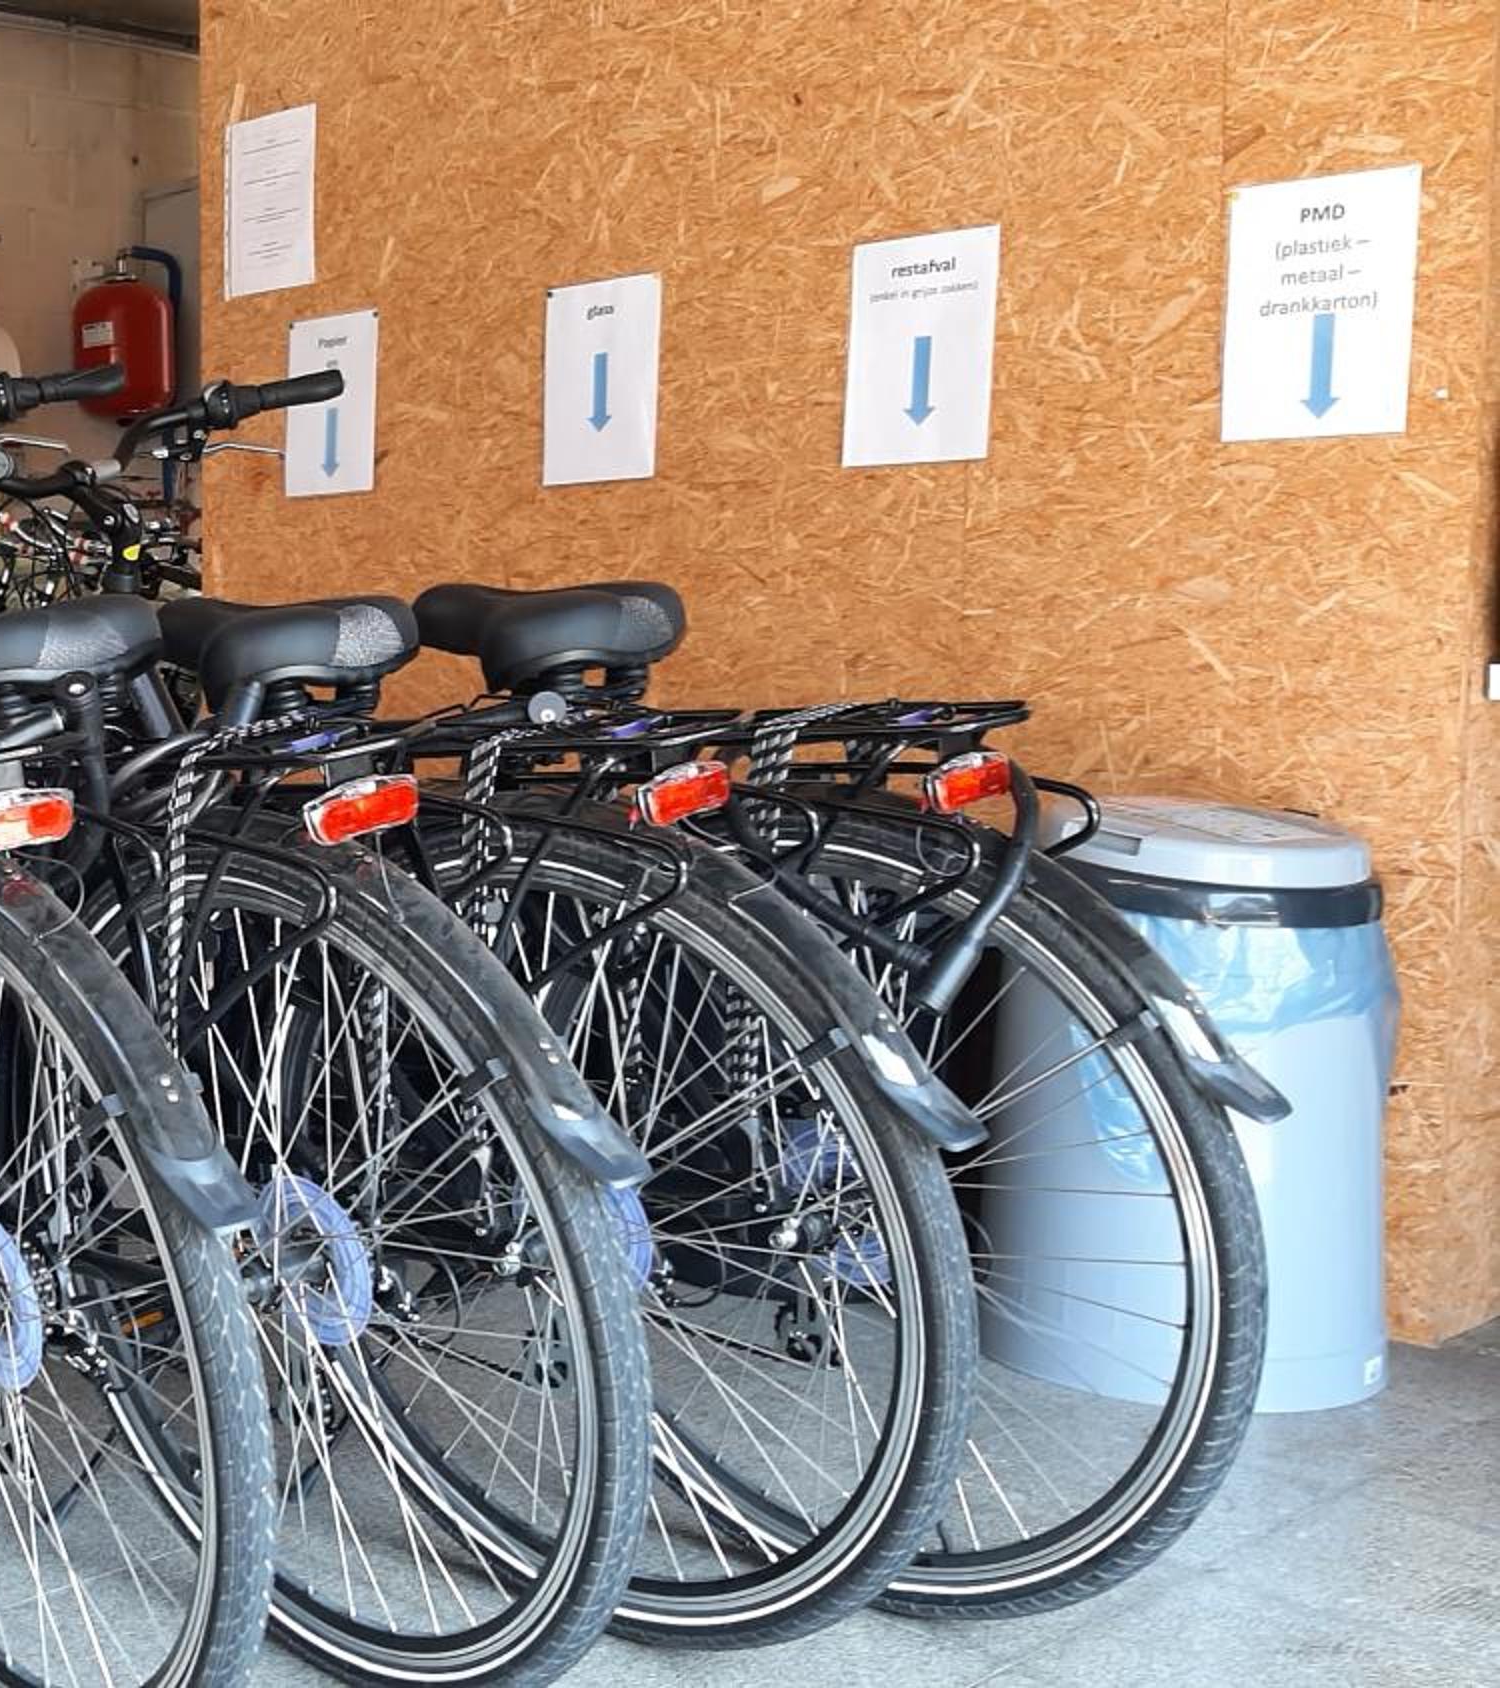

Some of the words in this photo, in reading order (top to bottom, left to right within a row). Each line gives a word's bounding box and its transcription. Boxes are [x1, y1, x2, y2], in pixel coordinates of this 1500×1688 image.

[1300, 203, 1345, 223] PMD
[1275, 233, 1352, 261] (plastiek
[891, 256, 957, 279] restafval
[1281, 262, 1343, 286] metaal
[1259, 289, 1378, 317] drankkarton)
